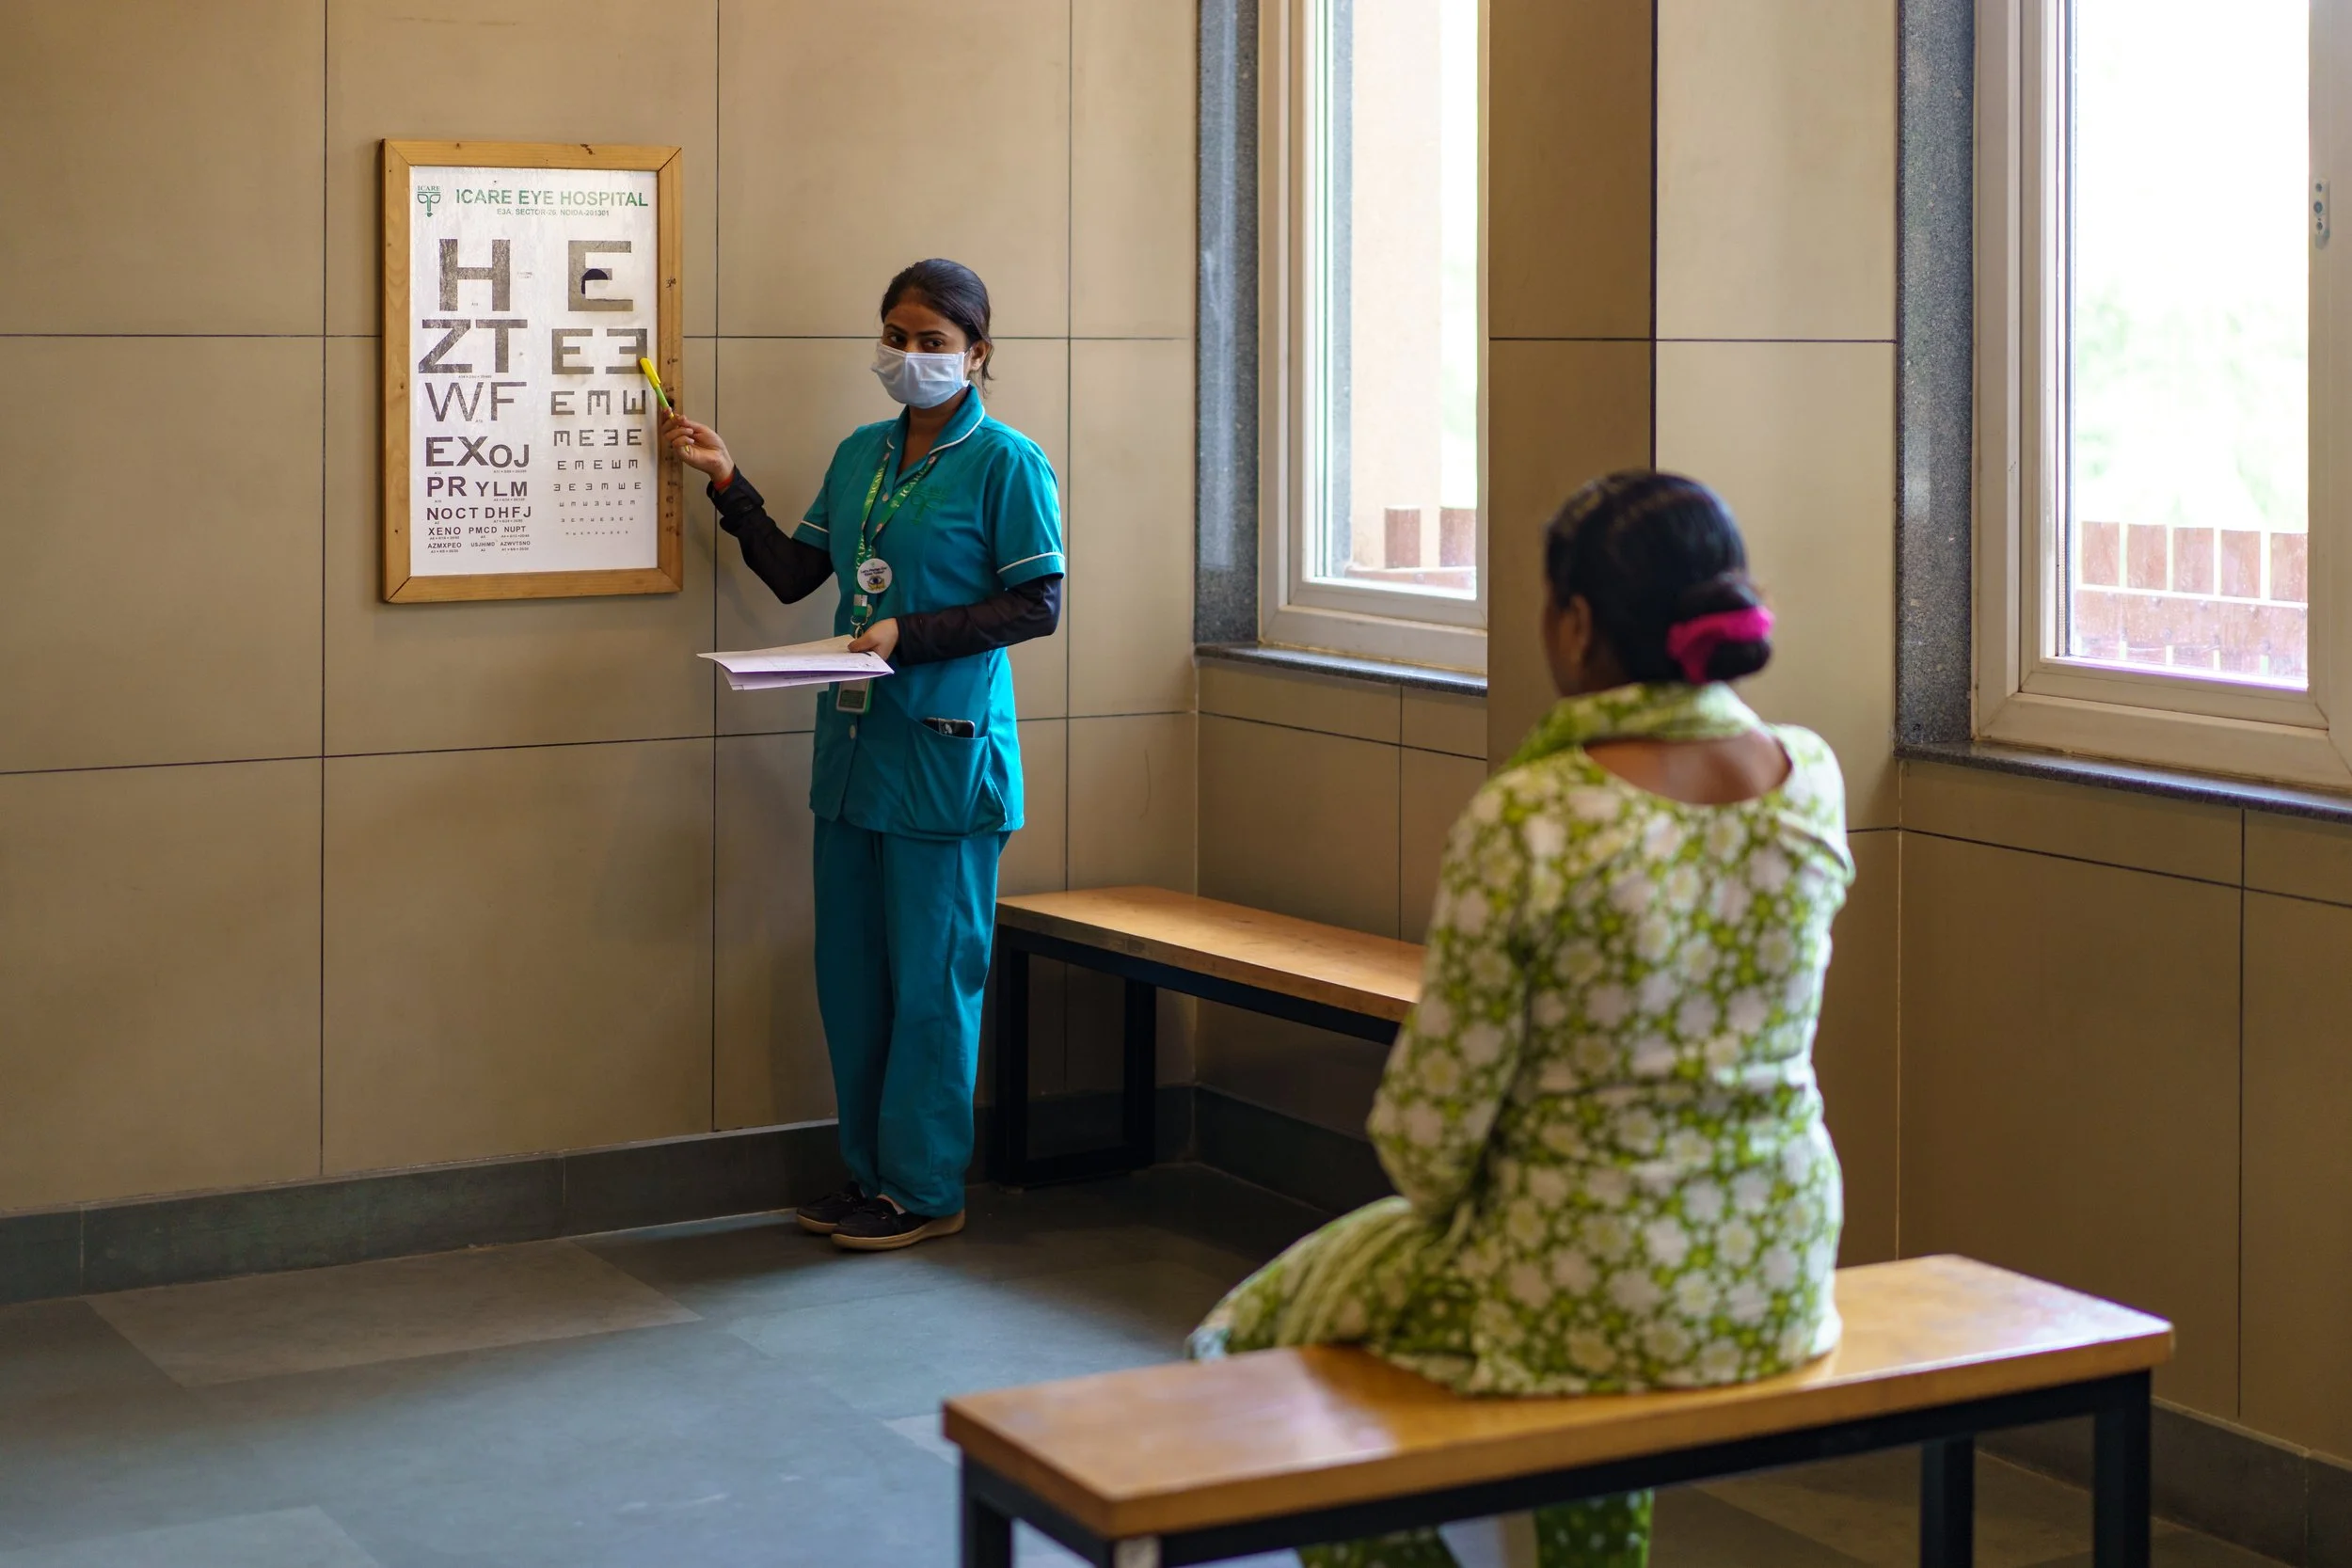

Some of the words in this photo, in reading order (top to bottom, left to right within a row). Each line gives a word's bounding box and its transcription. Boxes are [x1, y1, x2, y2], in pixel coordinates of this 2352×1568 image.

[456, 189, 513, 204] ICARE
[518, 190, 553, 205] EYE
[560, 191, 648, 207] HOSPITAL
[439, 239, 510, 311] H
[568, 241, 634, 311] E
[427, 507, 479, 520] NOCT
[485, 506, 532, 518] DHFJ
[428, 527, 461, 535] XENO
[469, 526, 498, 534] PMCD
